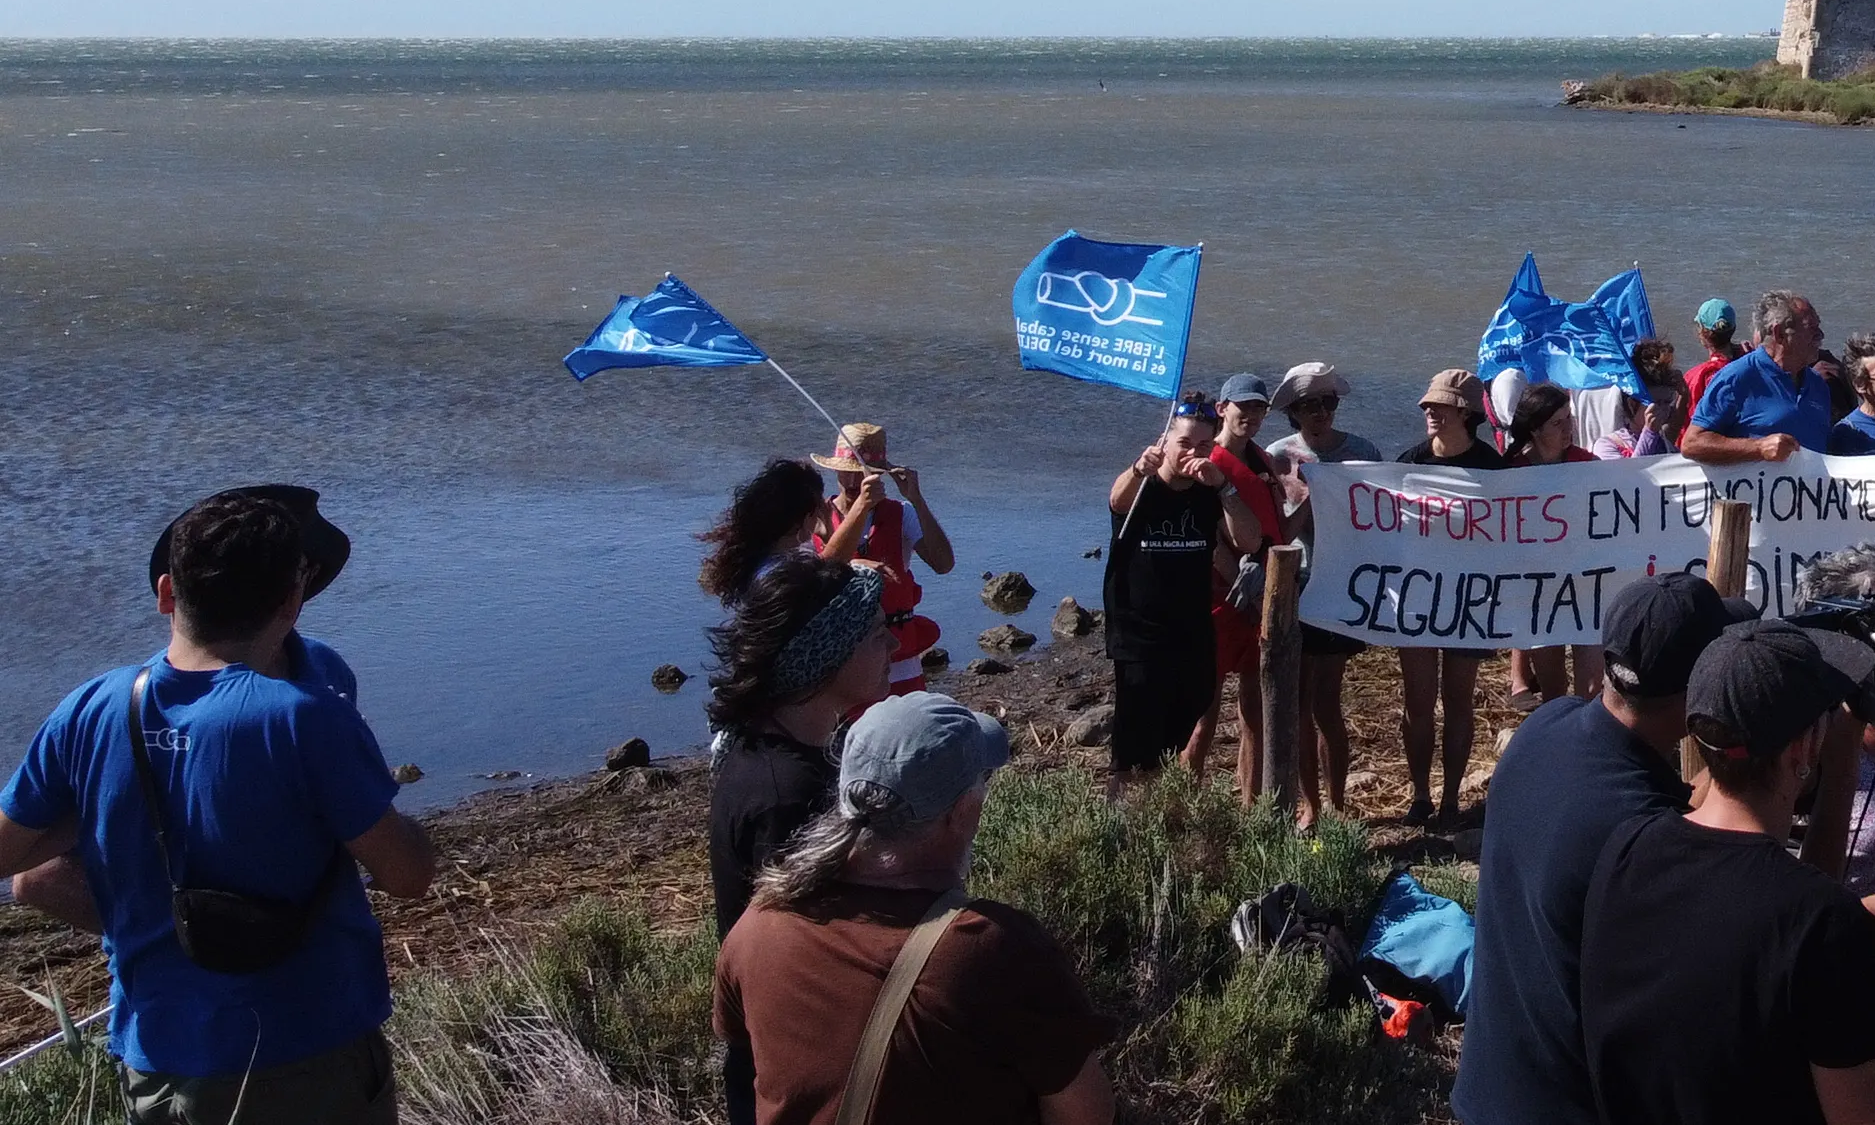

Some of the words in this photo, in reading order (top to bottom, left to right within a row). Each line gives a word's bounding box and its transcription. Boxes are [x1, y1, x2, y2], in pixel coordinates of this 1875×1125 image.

[1350, 481, 1568, 545] COMPORTES
[1588, 486, 1640, 539] EN
[1342, 564, 1616, 638] SEGURETAT
